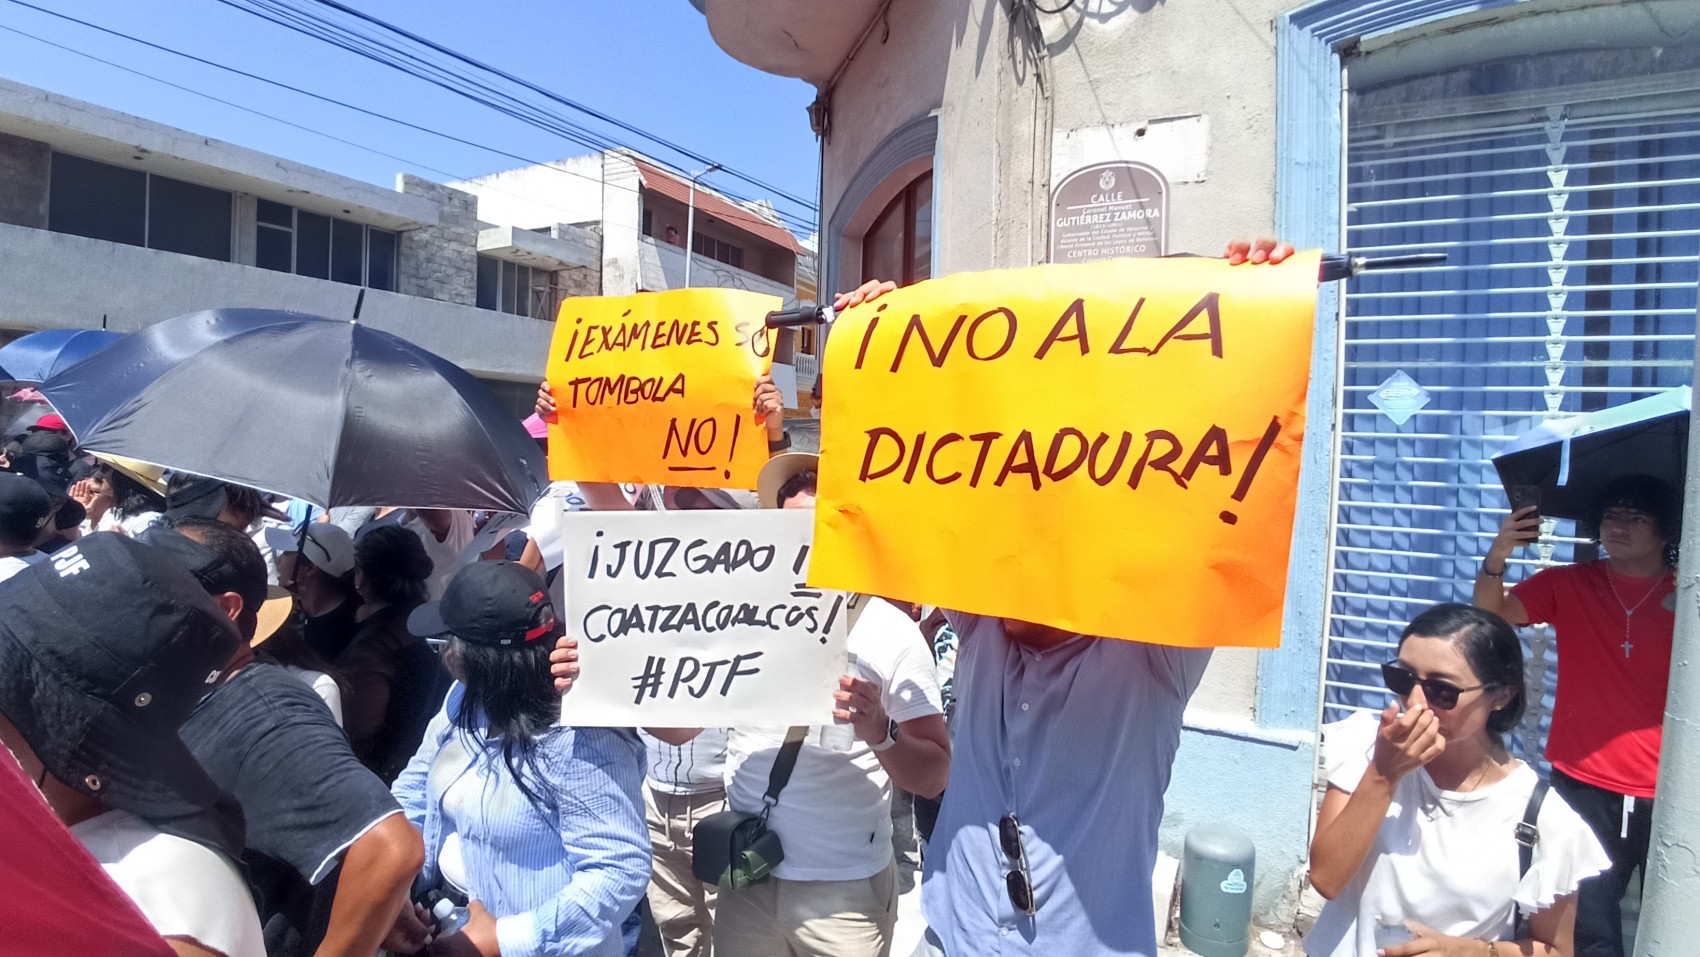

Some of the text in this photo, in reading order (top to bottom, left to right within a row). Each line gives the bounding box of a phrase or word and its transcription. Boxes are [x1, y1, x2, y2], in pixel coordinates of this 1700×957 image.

[1082, 203, 1132, 214] Coronel Manuel
[1090, 191, 1124, 204] CALLE
[1056, 208, 1160, 228] GUTIÉRREZ ZAMORA
[1067, 248, 1099, 258] CENTRO
[1101, 244, 1146, 255] HISTÓRICO
[564, 309, 720, 362] ¡EXÁMENES
[1033, 297, 1090, 360] A
[1107, 291, 1223, 360] LA
[568, 372, 686, 408] TOMBOLA
[858, 415, 1282, 526] DICTADURA!
[50, 545, 90, 578] PJF
[587, 530, 776, 580] ¡JUZGADO
[631, 651, 764, 706] #PJF
